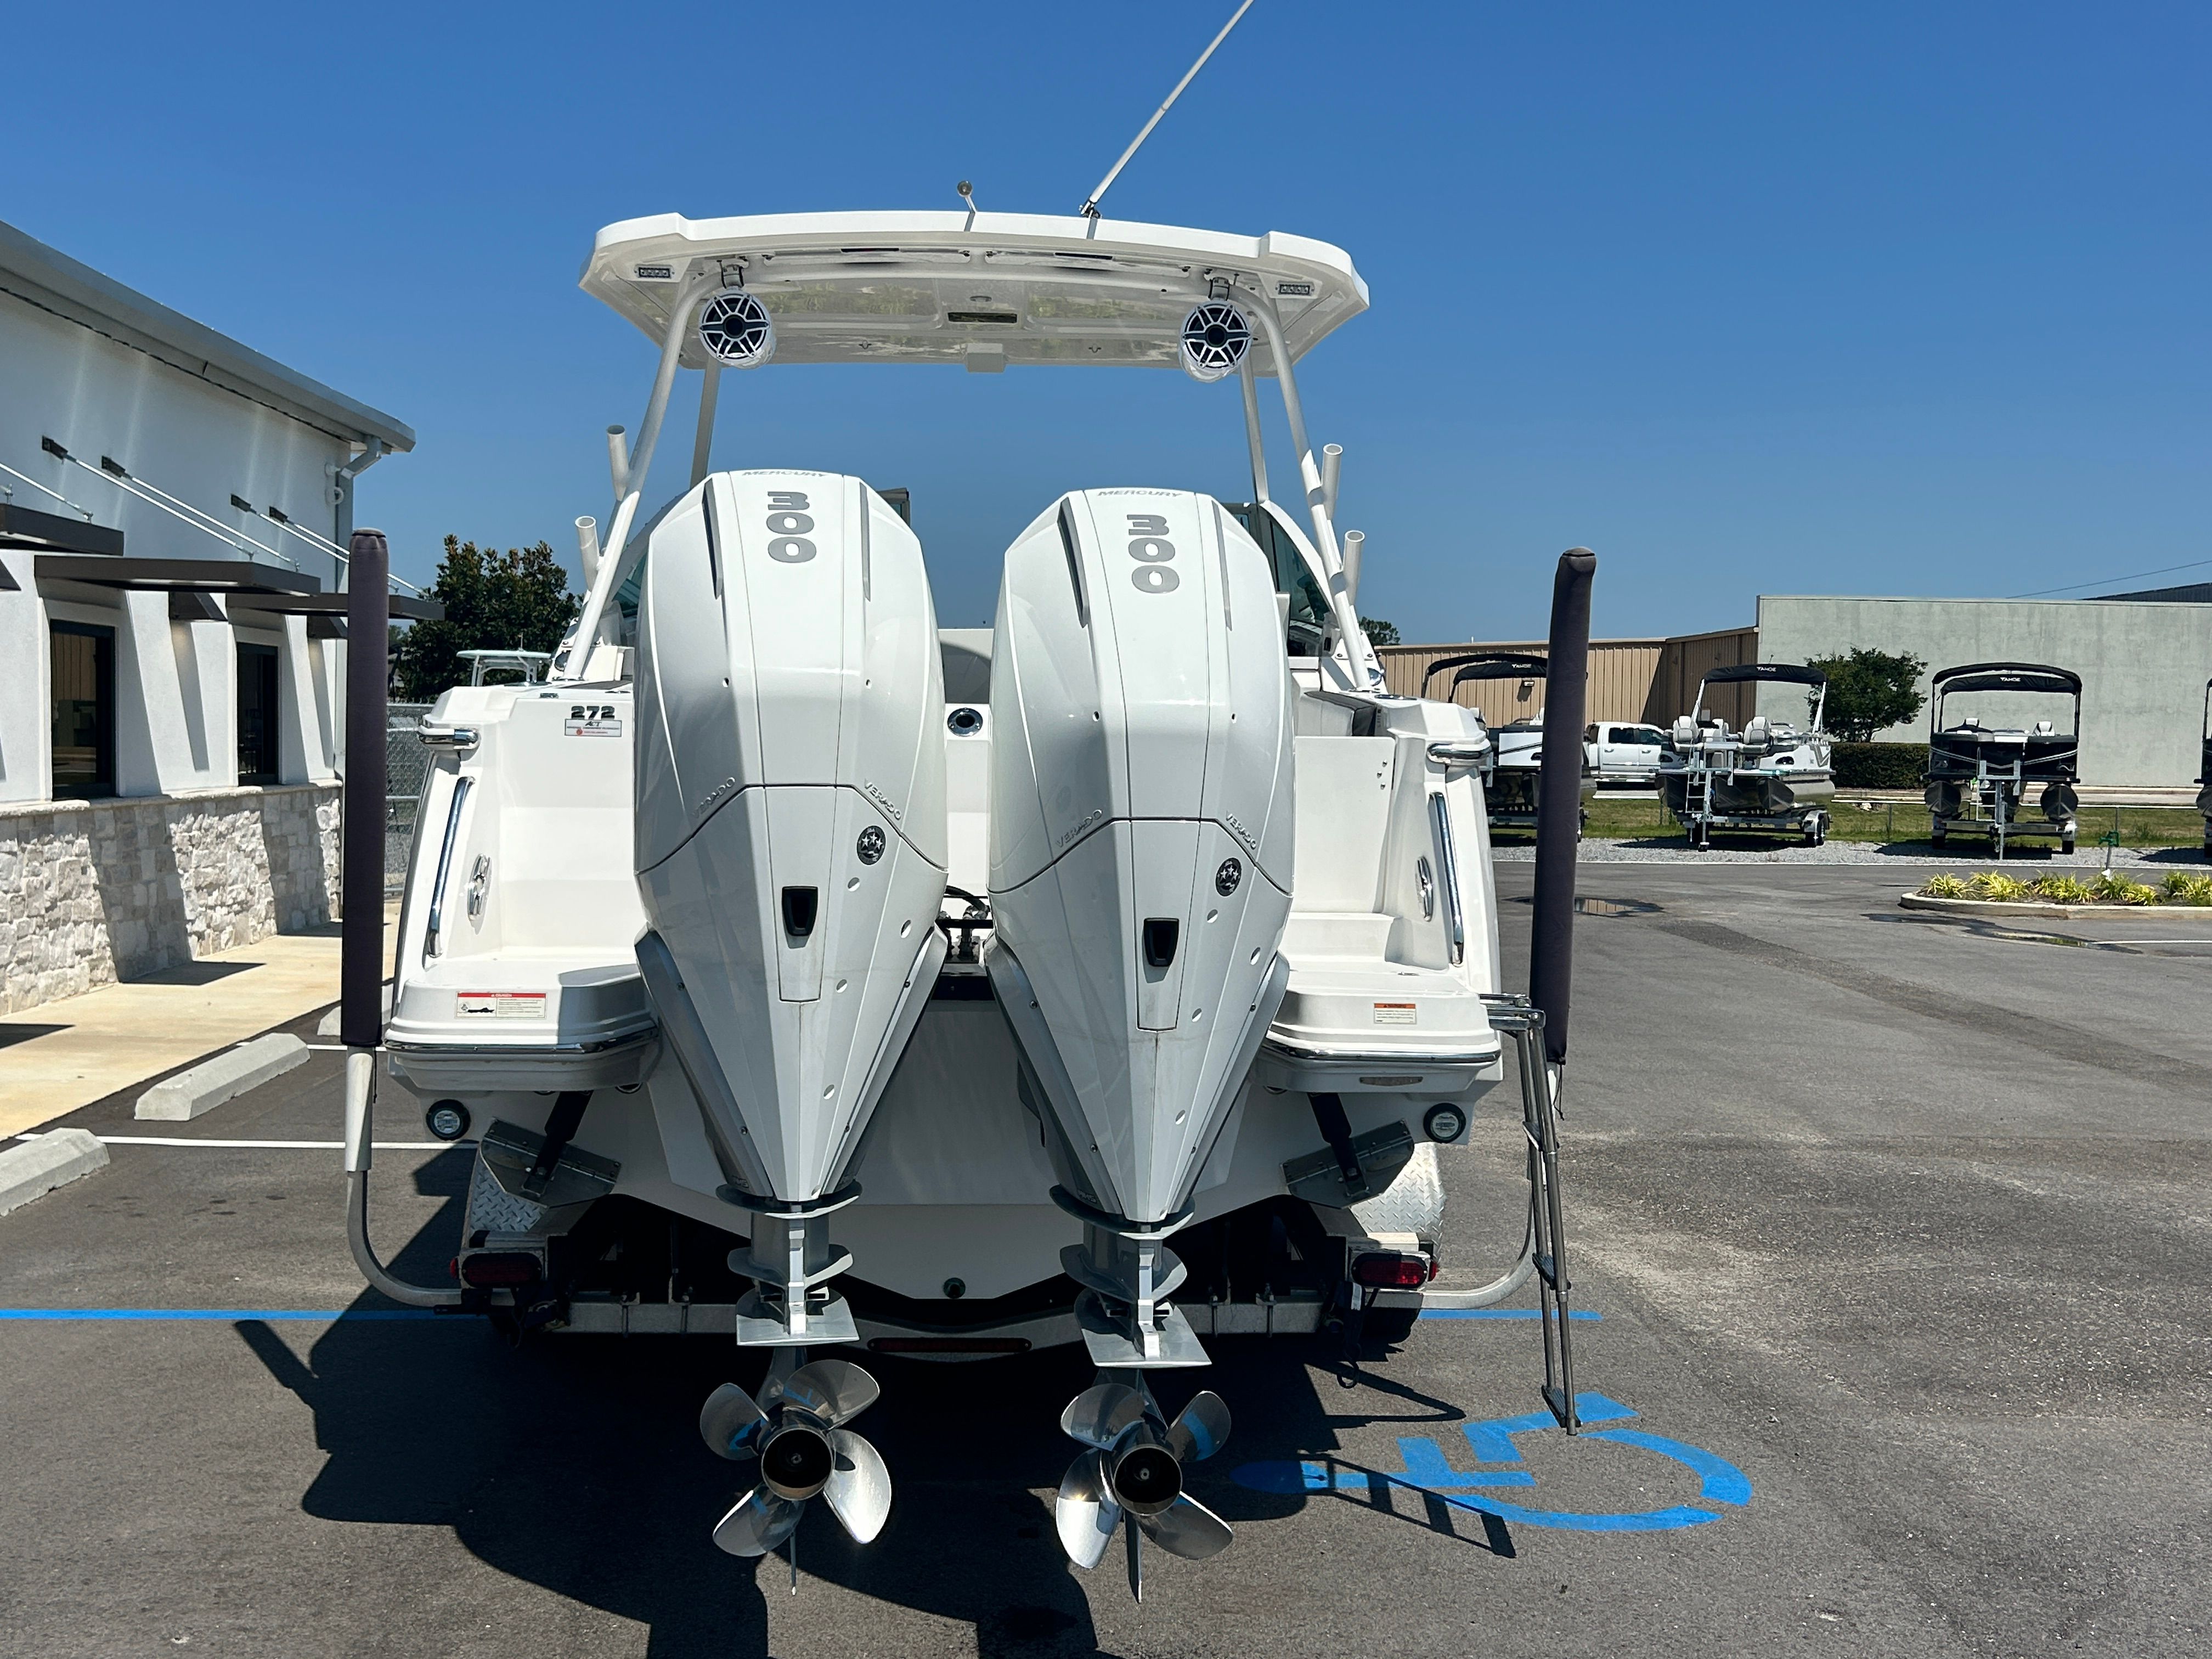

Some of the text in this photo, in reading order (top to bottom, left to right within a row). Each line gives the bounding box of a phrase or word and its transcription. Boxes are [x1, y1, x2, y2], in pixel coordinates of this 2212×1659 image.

[766, 491, 817, 563] 300
[1126, 514, 1180, 594] 300
[571, 705, 615, 720] 272
[691, 776, 736, 819] VERADO
[864, 777, 901, 821] VERADO
[1056, 809, 1103, 848] VERADO
[1226, 809, 1257, 850] VERADO
